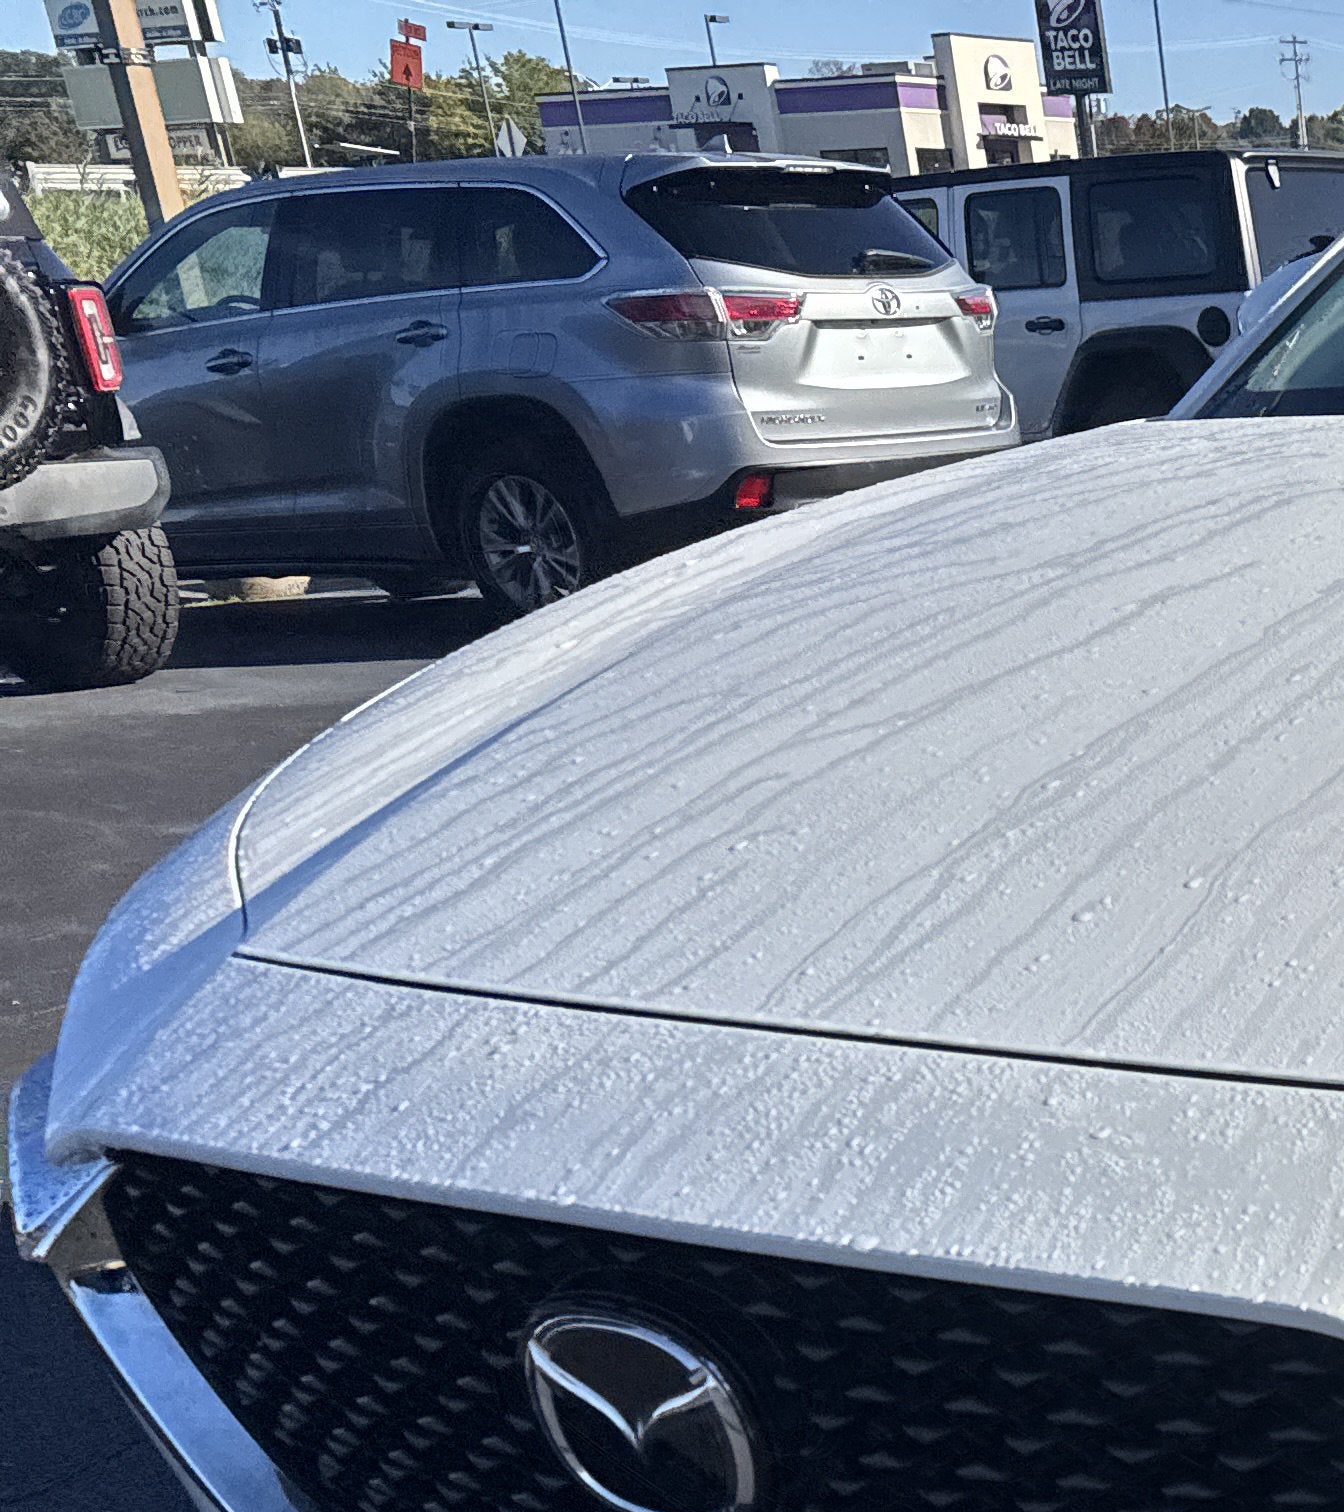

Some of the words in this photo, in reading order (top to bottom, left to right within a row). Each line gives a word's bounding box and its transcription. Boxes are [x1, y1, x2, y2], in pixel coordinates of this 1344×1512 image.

[1045, 28, 1093, 50] TACO
[1052, 50, 1096, 70] BELL
[994, 122, 1019, 136] TACO
